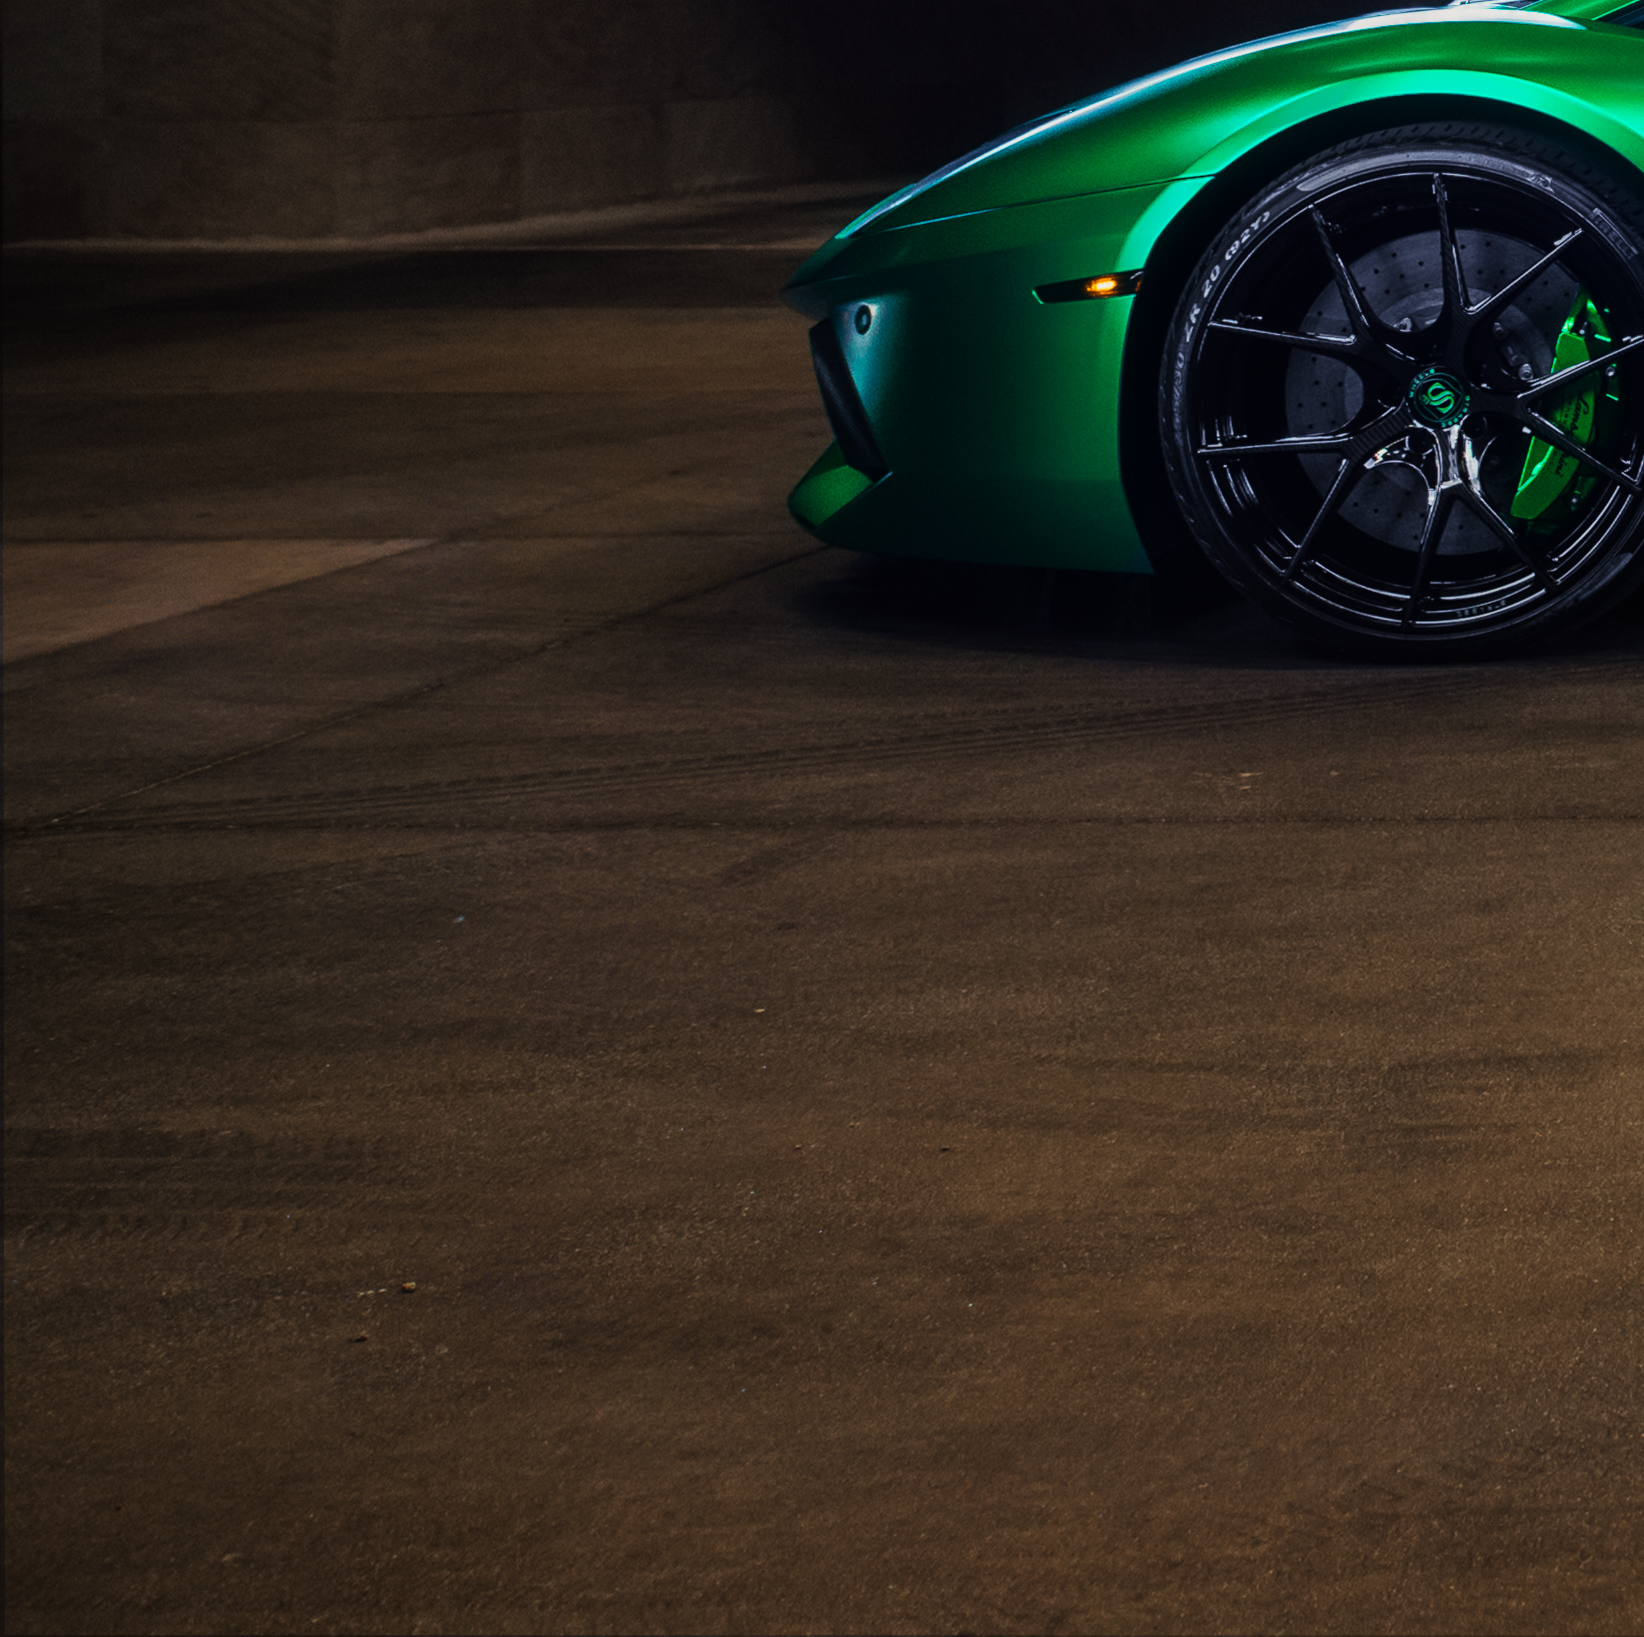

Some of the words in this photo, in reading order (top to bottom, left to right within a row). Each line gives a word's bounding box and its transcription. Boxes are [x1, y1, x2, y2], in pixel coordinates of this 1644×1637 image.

[1184, 302, 1202, 343] ZR
[1201, 264, 1221, 300] 20
[1224, 210, 1271, 261] (92Y)
